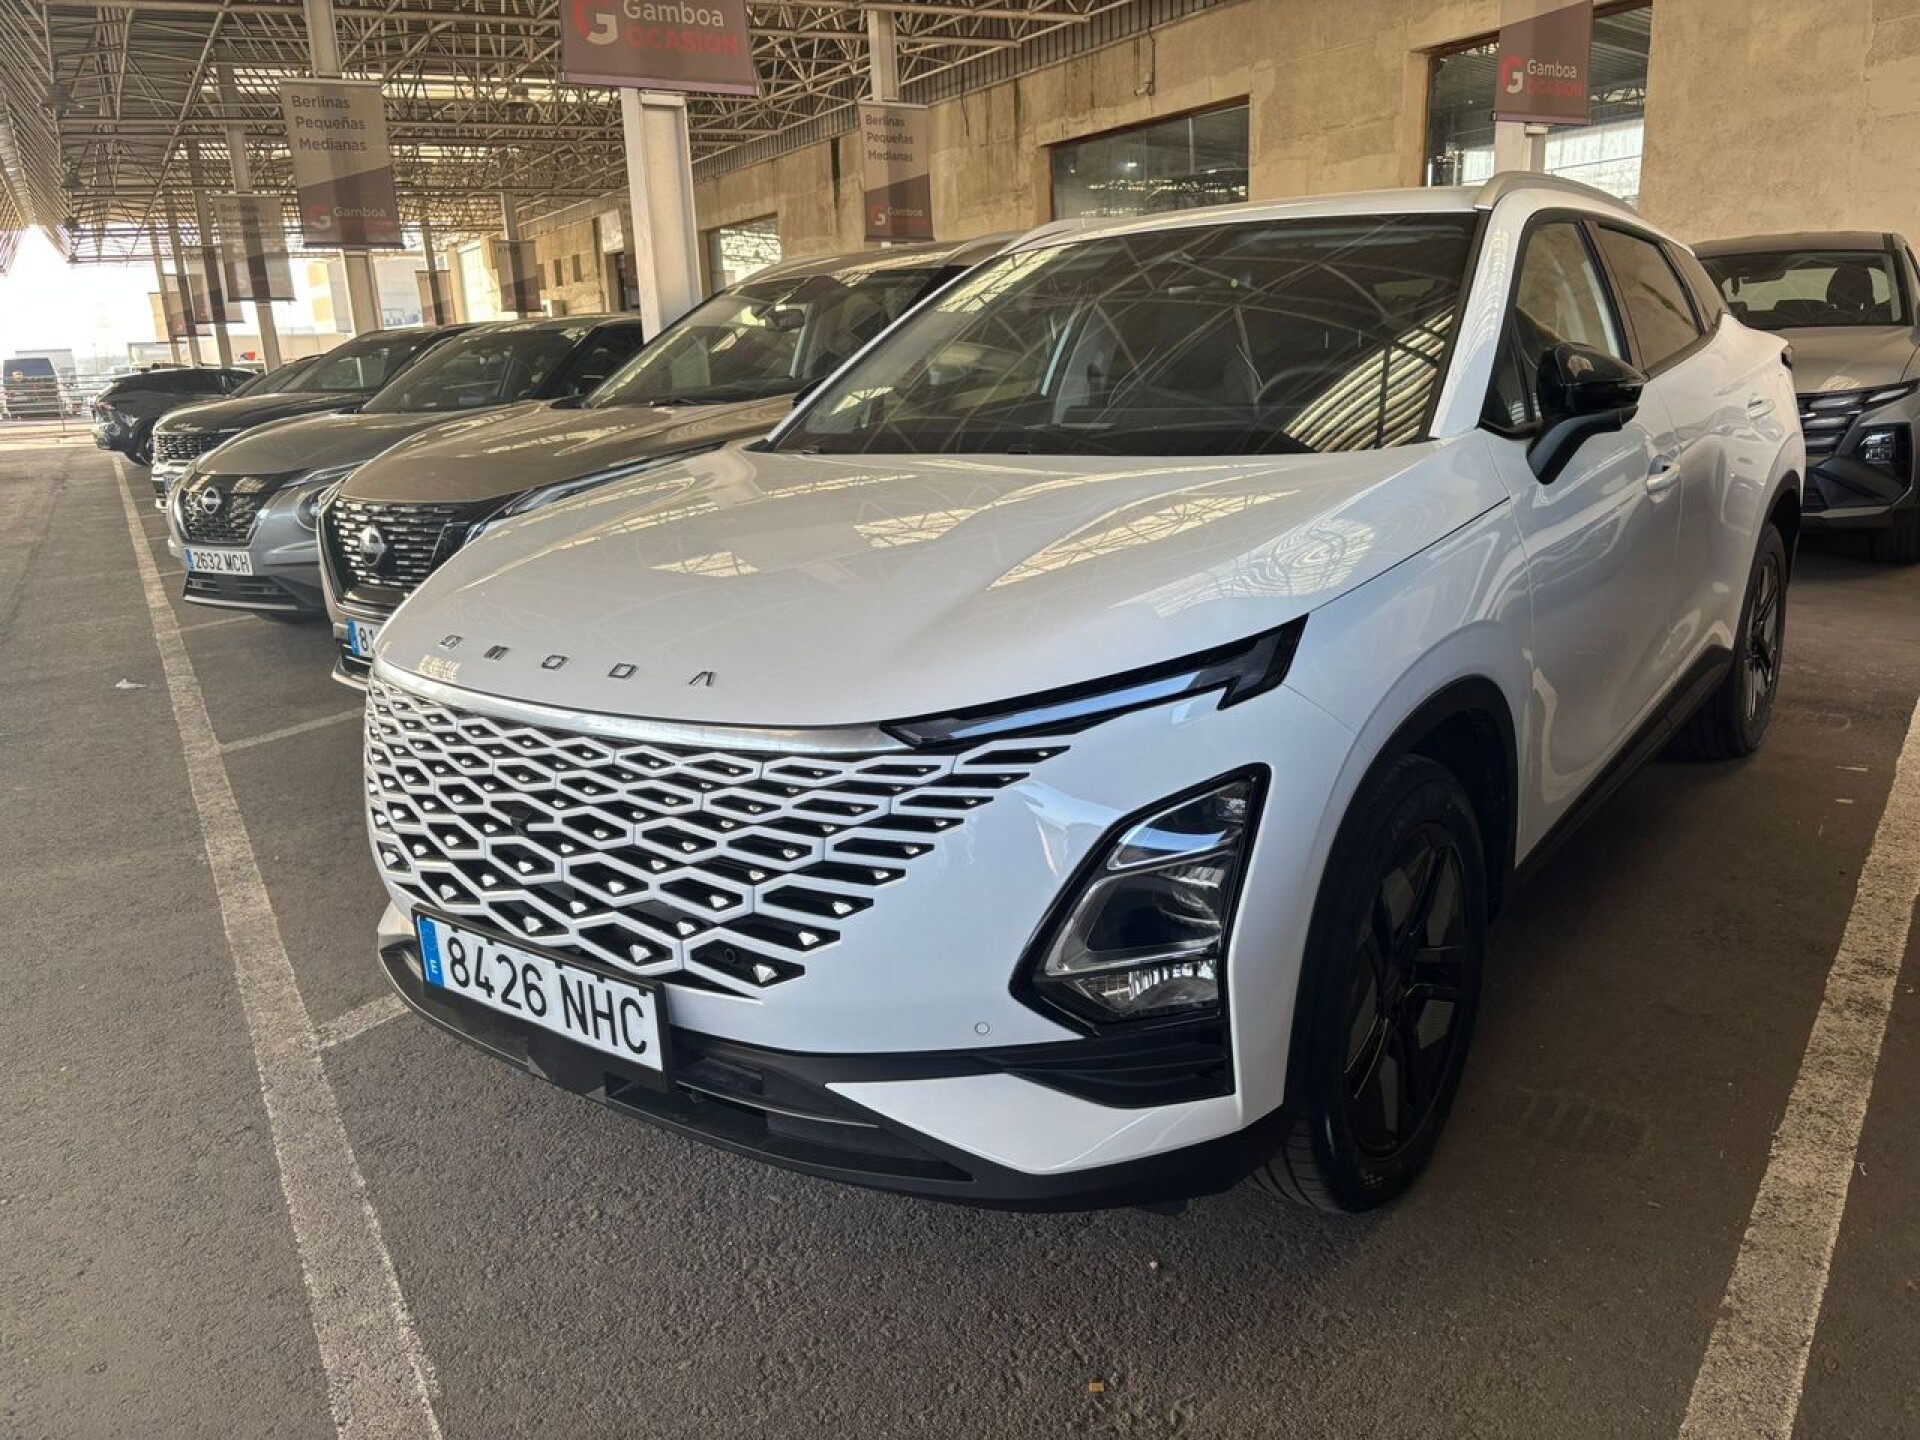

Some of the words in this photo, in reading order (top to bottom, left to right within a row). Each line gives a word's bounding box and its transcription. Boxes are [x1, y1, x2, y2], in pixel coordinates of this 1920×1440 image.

[623, 0, 724, 27] Gamboa
[1526, 59, 1578, 79] Gamboa
[291, 95, 351, 109] Berlinas
[295, 116, 367, 131] Pequeñas
[298, 137, 368, 152] Medianas
[332, 206, 387, 218] Gamboa
[193, 551, 222, 571] 2632
[430, 958, 439, 975] E
[447, 936, 547, 1018] 8426
[559, 973, 648, 1054] NHC
